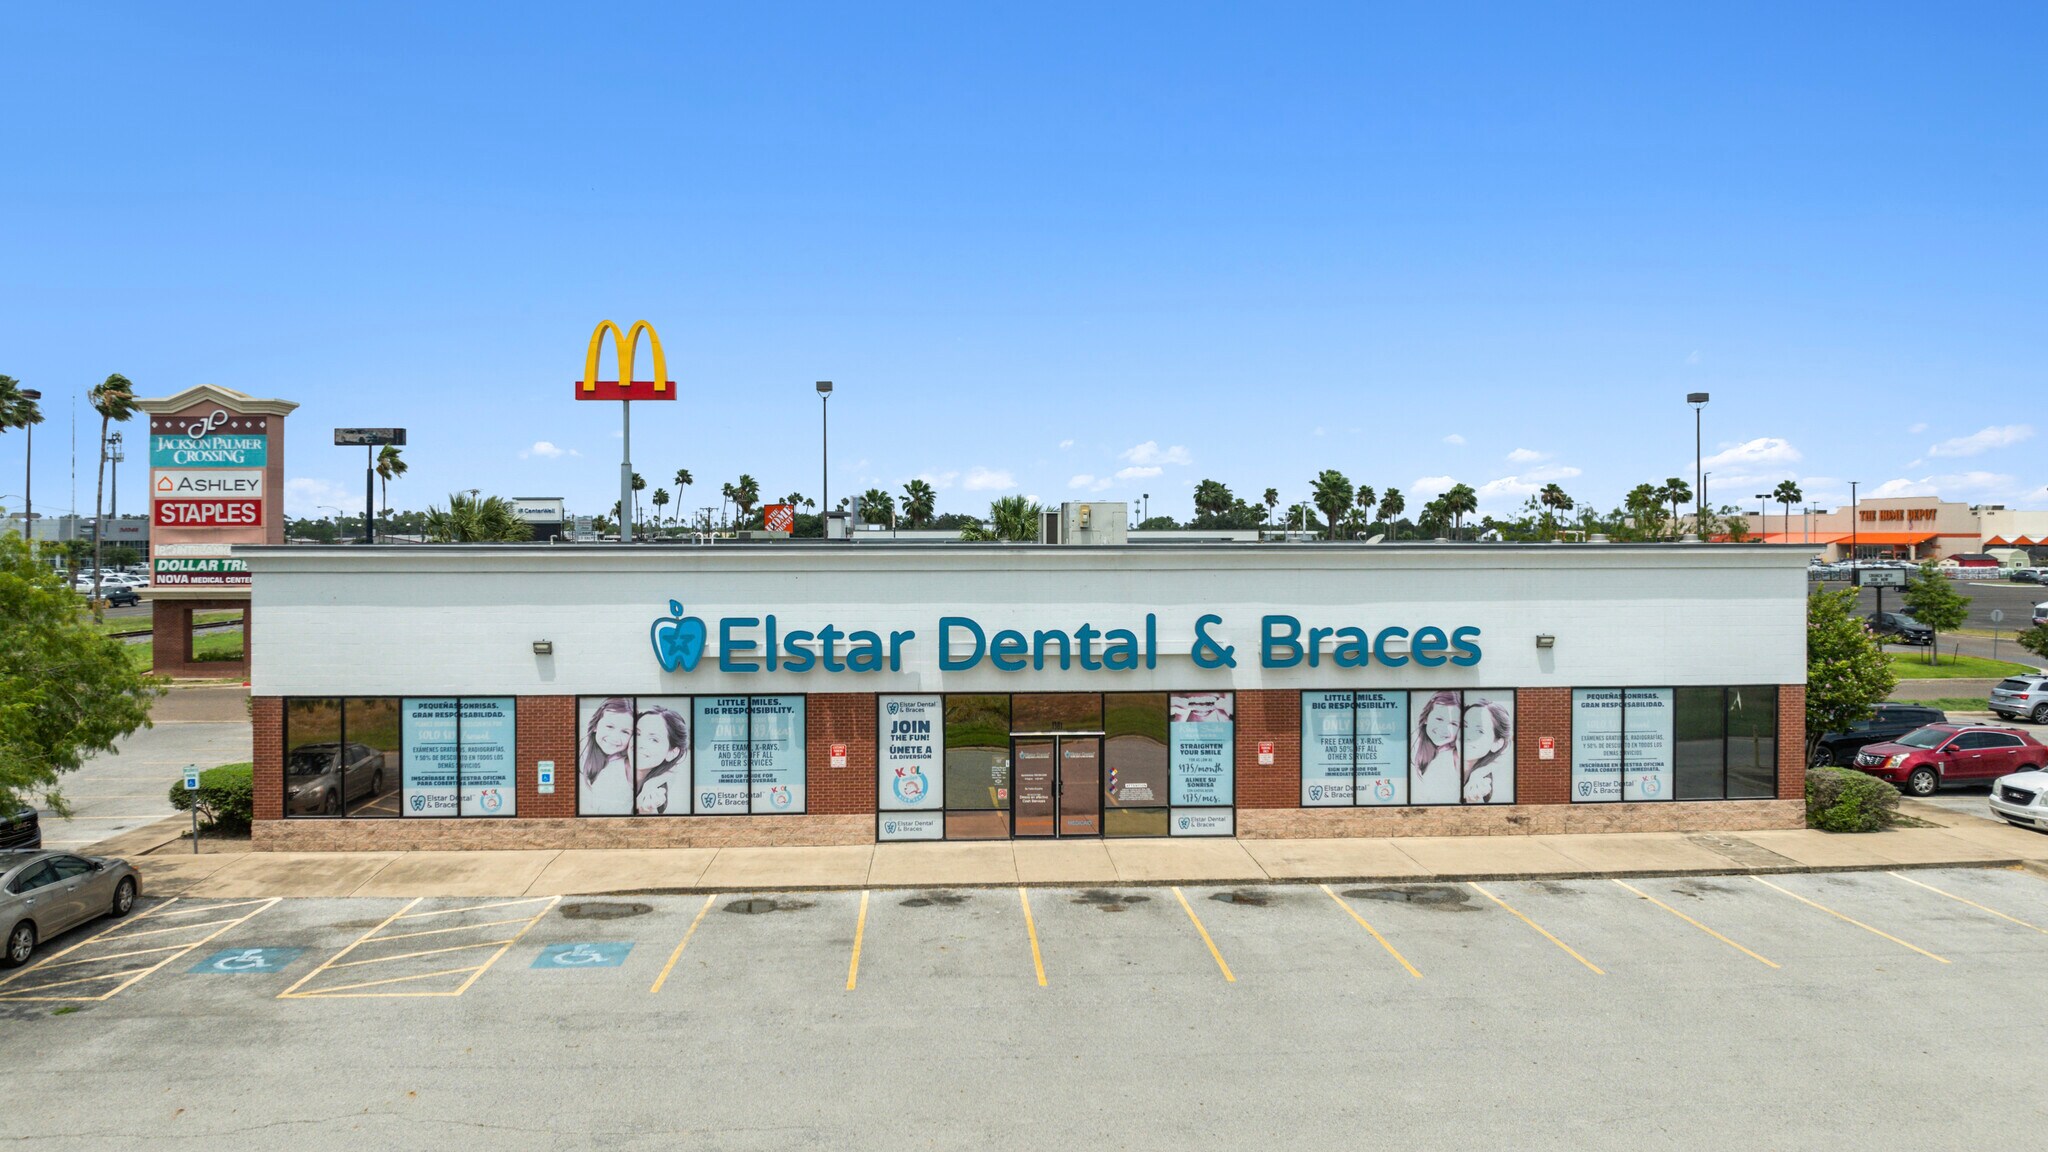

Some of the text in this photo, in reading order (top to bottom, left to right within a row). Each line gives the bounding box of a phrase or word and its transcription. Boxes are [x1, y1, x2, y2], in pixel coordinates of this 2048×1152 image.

[156, 437, 262, 452] JACKSON PALMER
[173, 449, 245, 464] CROSSING
[177, 476, 259, 491] ASHLEY
[161, 502, 256, 523] STAPLES
[1859, 508, 1937, 521] THE HOME DEPOT
[157, 559, 219, 571] DOLLAR
[157, 574, 189, 584] NOVA
[191, 576, 224, 584] MEDICAL
[719, 613, 1482, 673] Elstar Dental & Braces
[891, 720, 930, 734] JOIN
[714, 744, 780, 752] FREE X-RAYS,
[890, 744, 932, 754] ÚNETE A
[721, 759, 741, 767] OTHER
